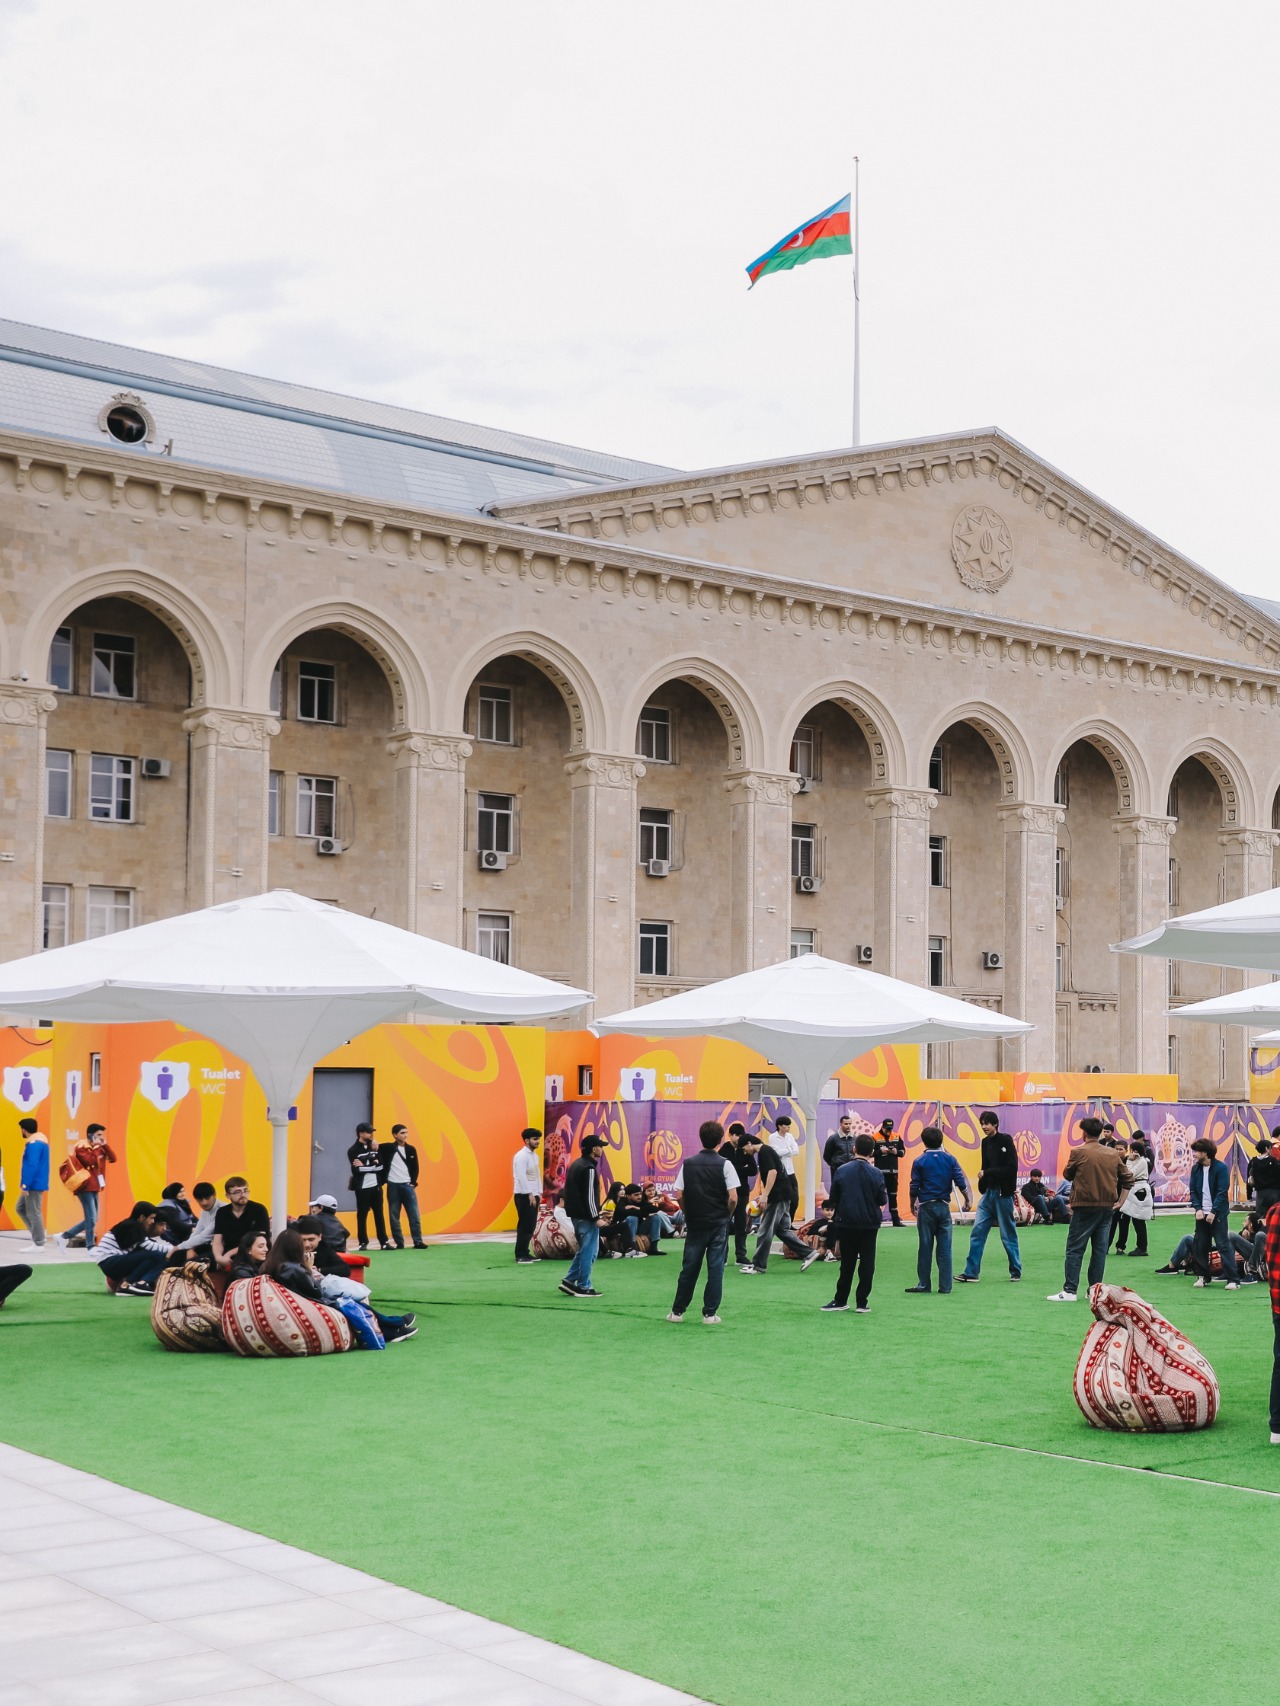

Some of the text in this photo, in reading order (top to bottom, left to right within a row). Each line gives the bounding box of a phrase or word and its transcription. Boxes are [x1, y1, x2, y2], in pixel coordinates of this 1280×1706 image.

[201, 1068, 240, 1079] Tualet
[664, 1073, 694, 1083] Tualet
[201, 1083, 226, 1095] WC
[664, 1086, 683, 1096] WC
